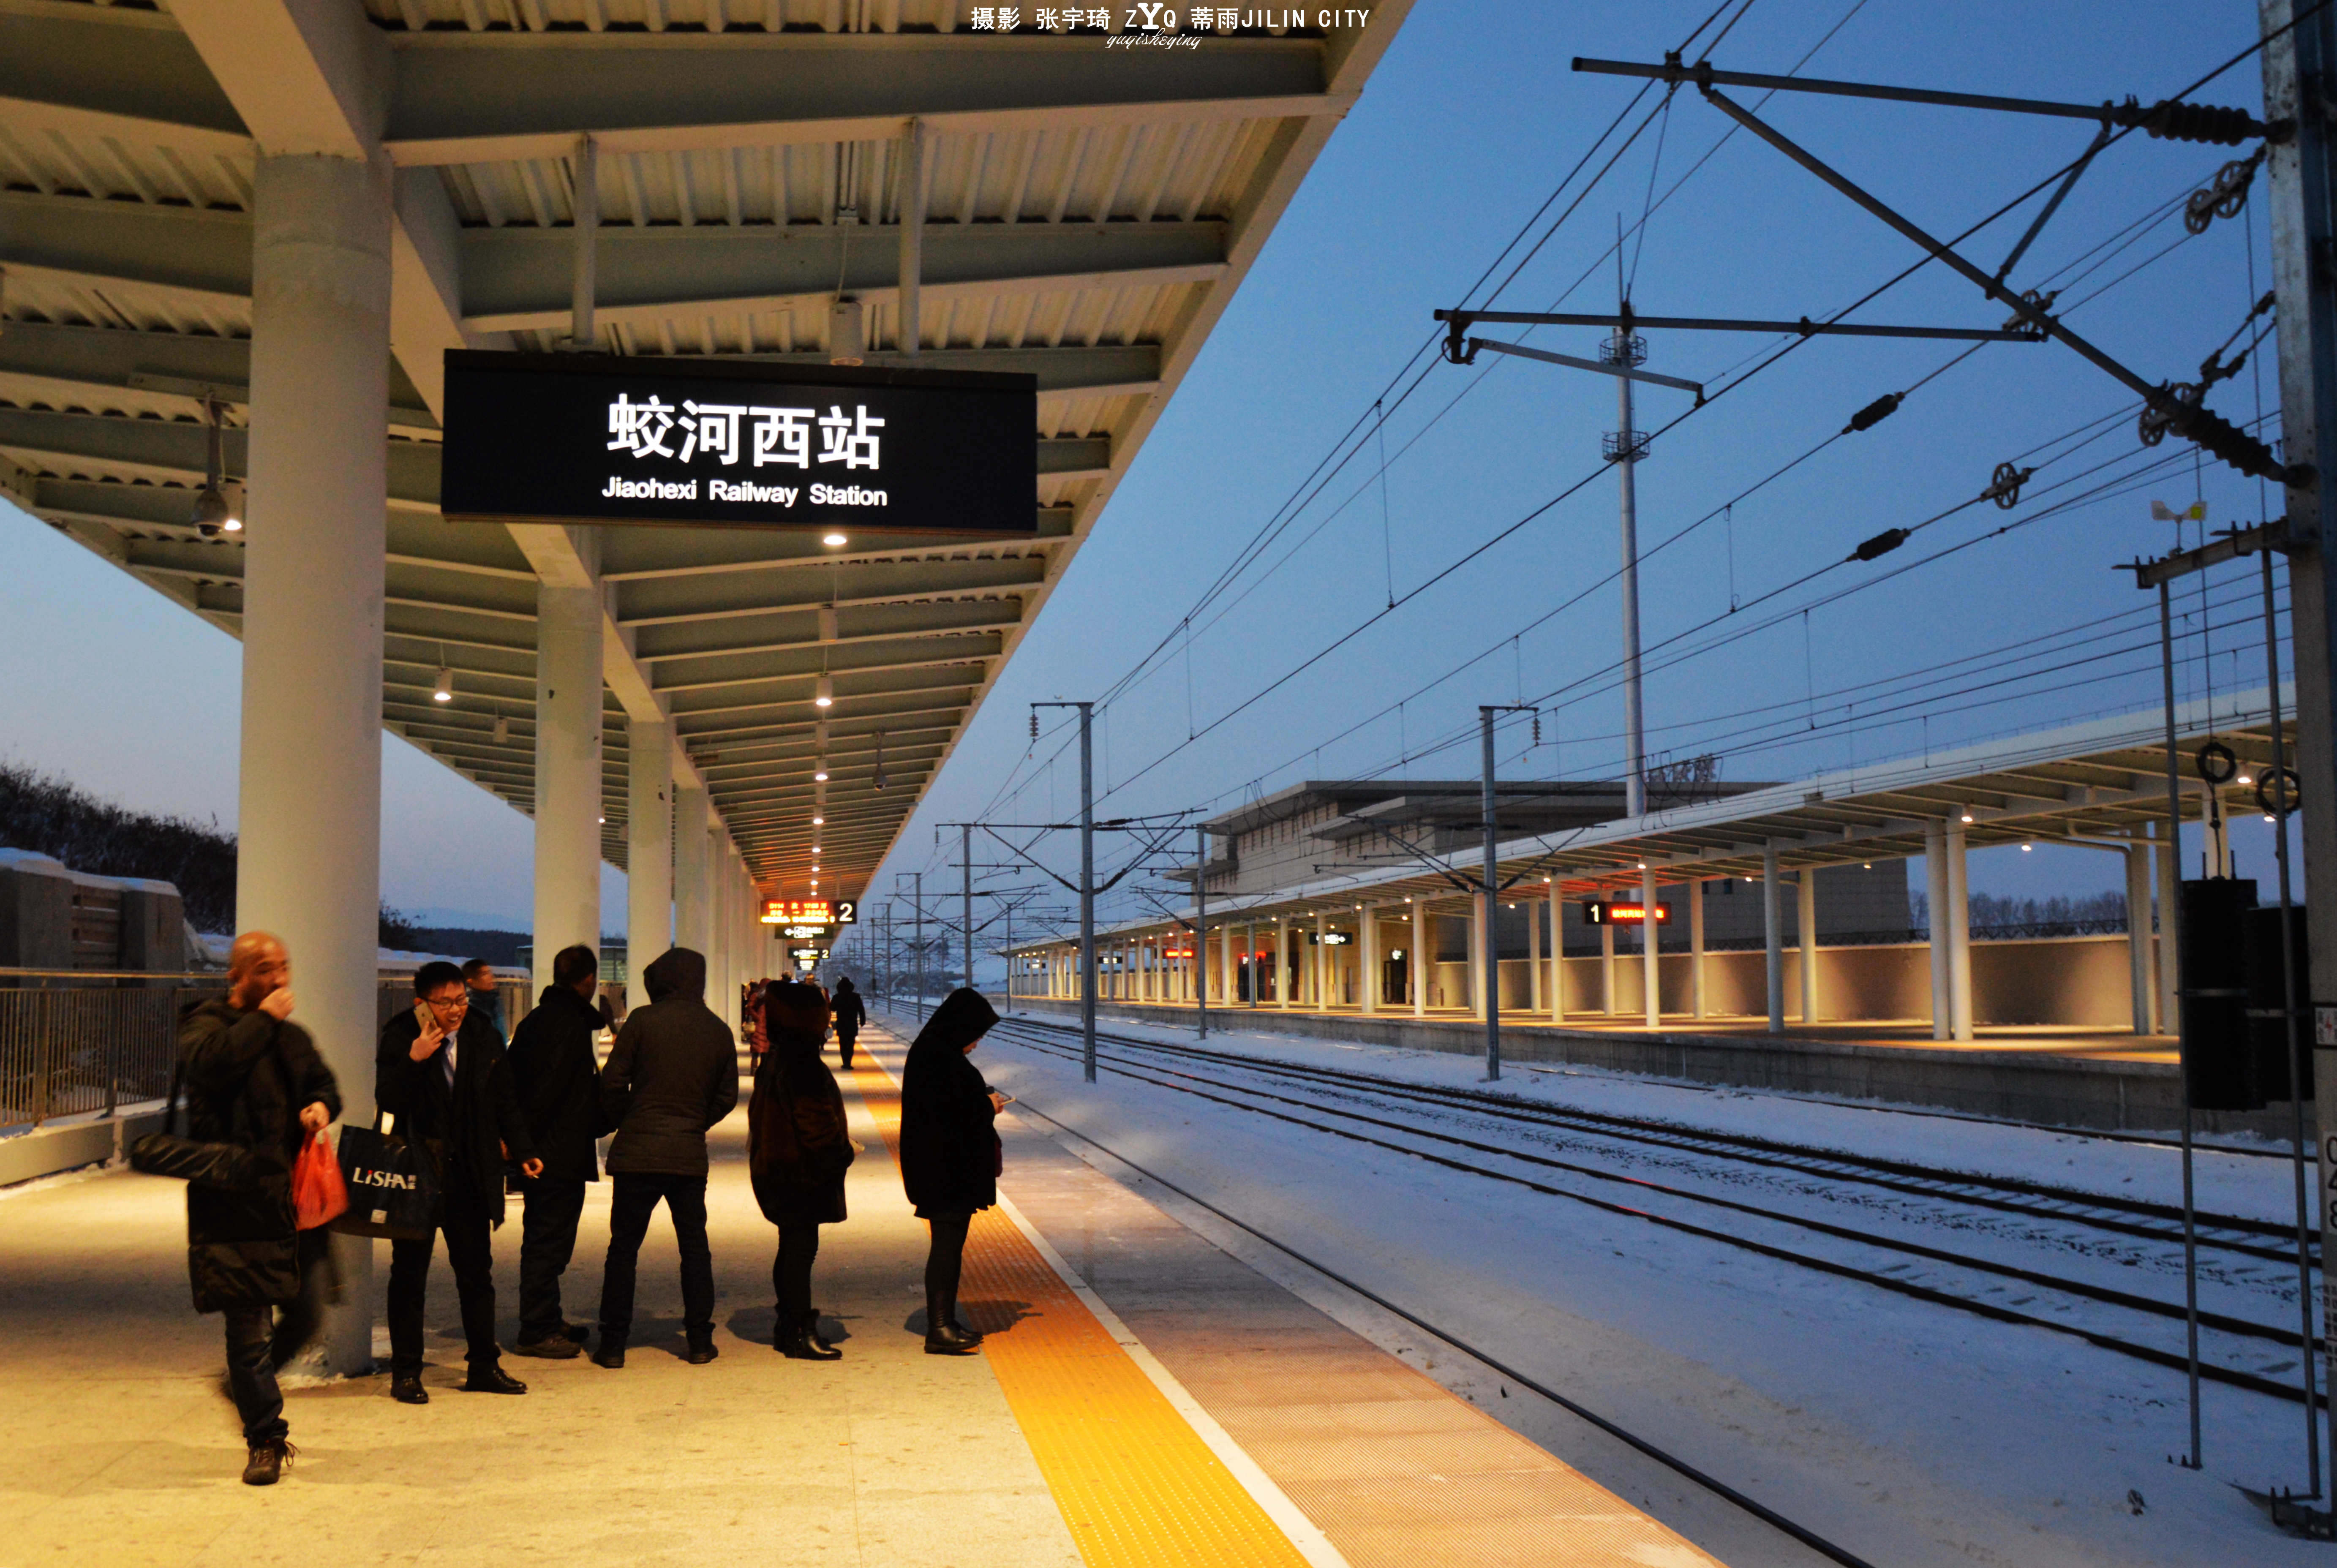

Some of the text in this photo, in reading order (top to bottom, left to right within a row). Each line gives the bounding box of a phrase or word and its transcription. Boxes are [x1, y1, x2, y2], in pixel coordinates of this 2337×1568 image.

[607, 393, 885, 470] 蛟河西站
[602, 476, 887, 508] Jiaohexi Railway Station
[839, 903, 853, 922] 2
[1591, 904, 1599, 922] 1
[822, 950, 828, 958] 2
